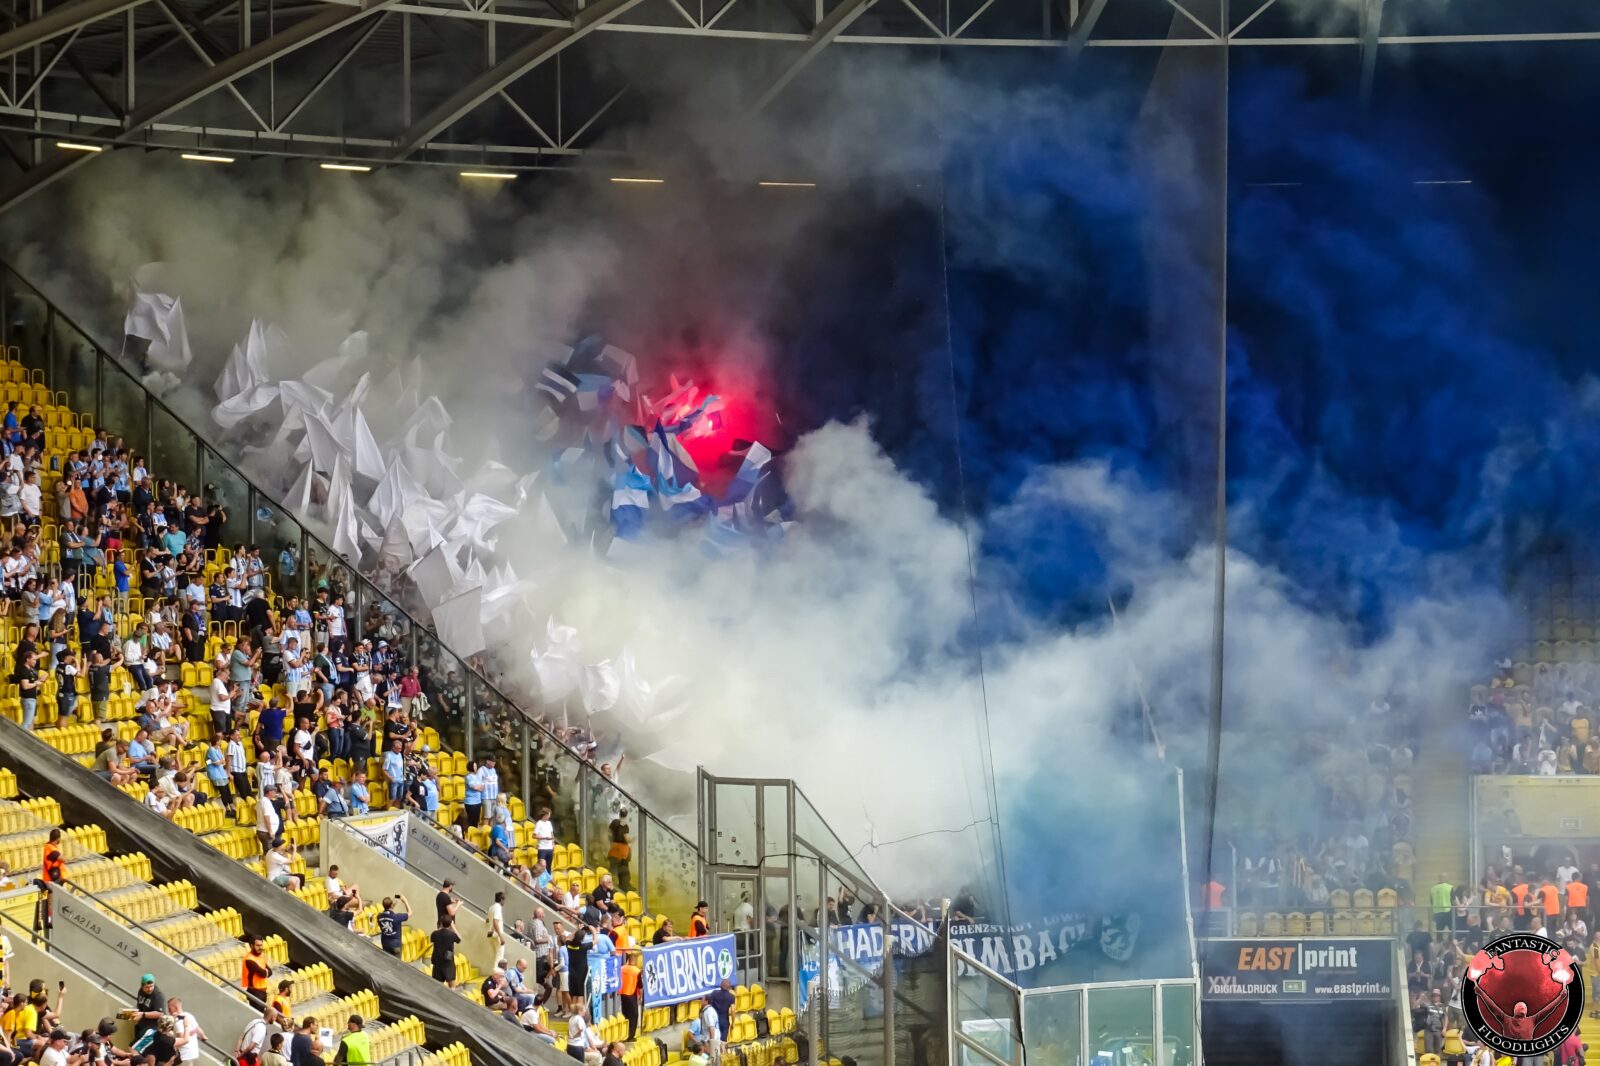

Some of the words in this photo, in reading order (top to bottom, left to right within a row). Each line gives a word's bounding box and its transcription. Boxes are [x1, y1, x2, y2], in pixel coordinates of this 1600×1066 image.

[74, 914, 86, 925] A2
[90, 924, 101, 935] A3
[116, 941, 128, 951] A1
[1237, 947, 1296, 971] EAST
[1305, 946, 1358, 970] print
[656, 945, 716, 997] AUBING
[1214, 984, 1278, 994] DIGITALDRUCK
[1315, 982, 1390, 996] www.eastprint.de
